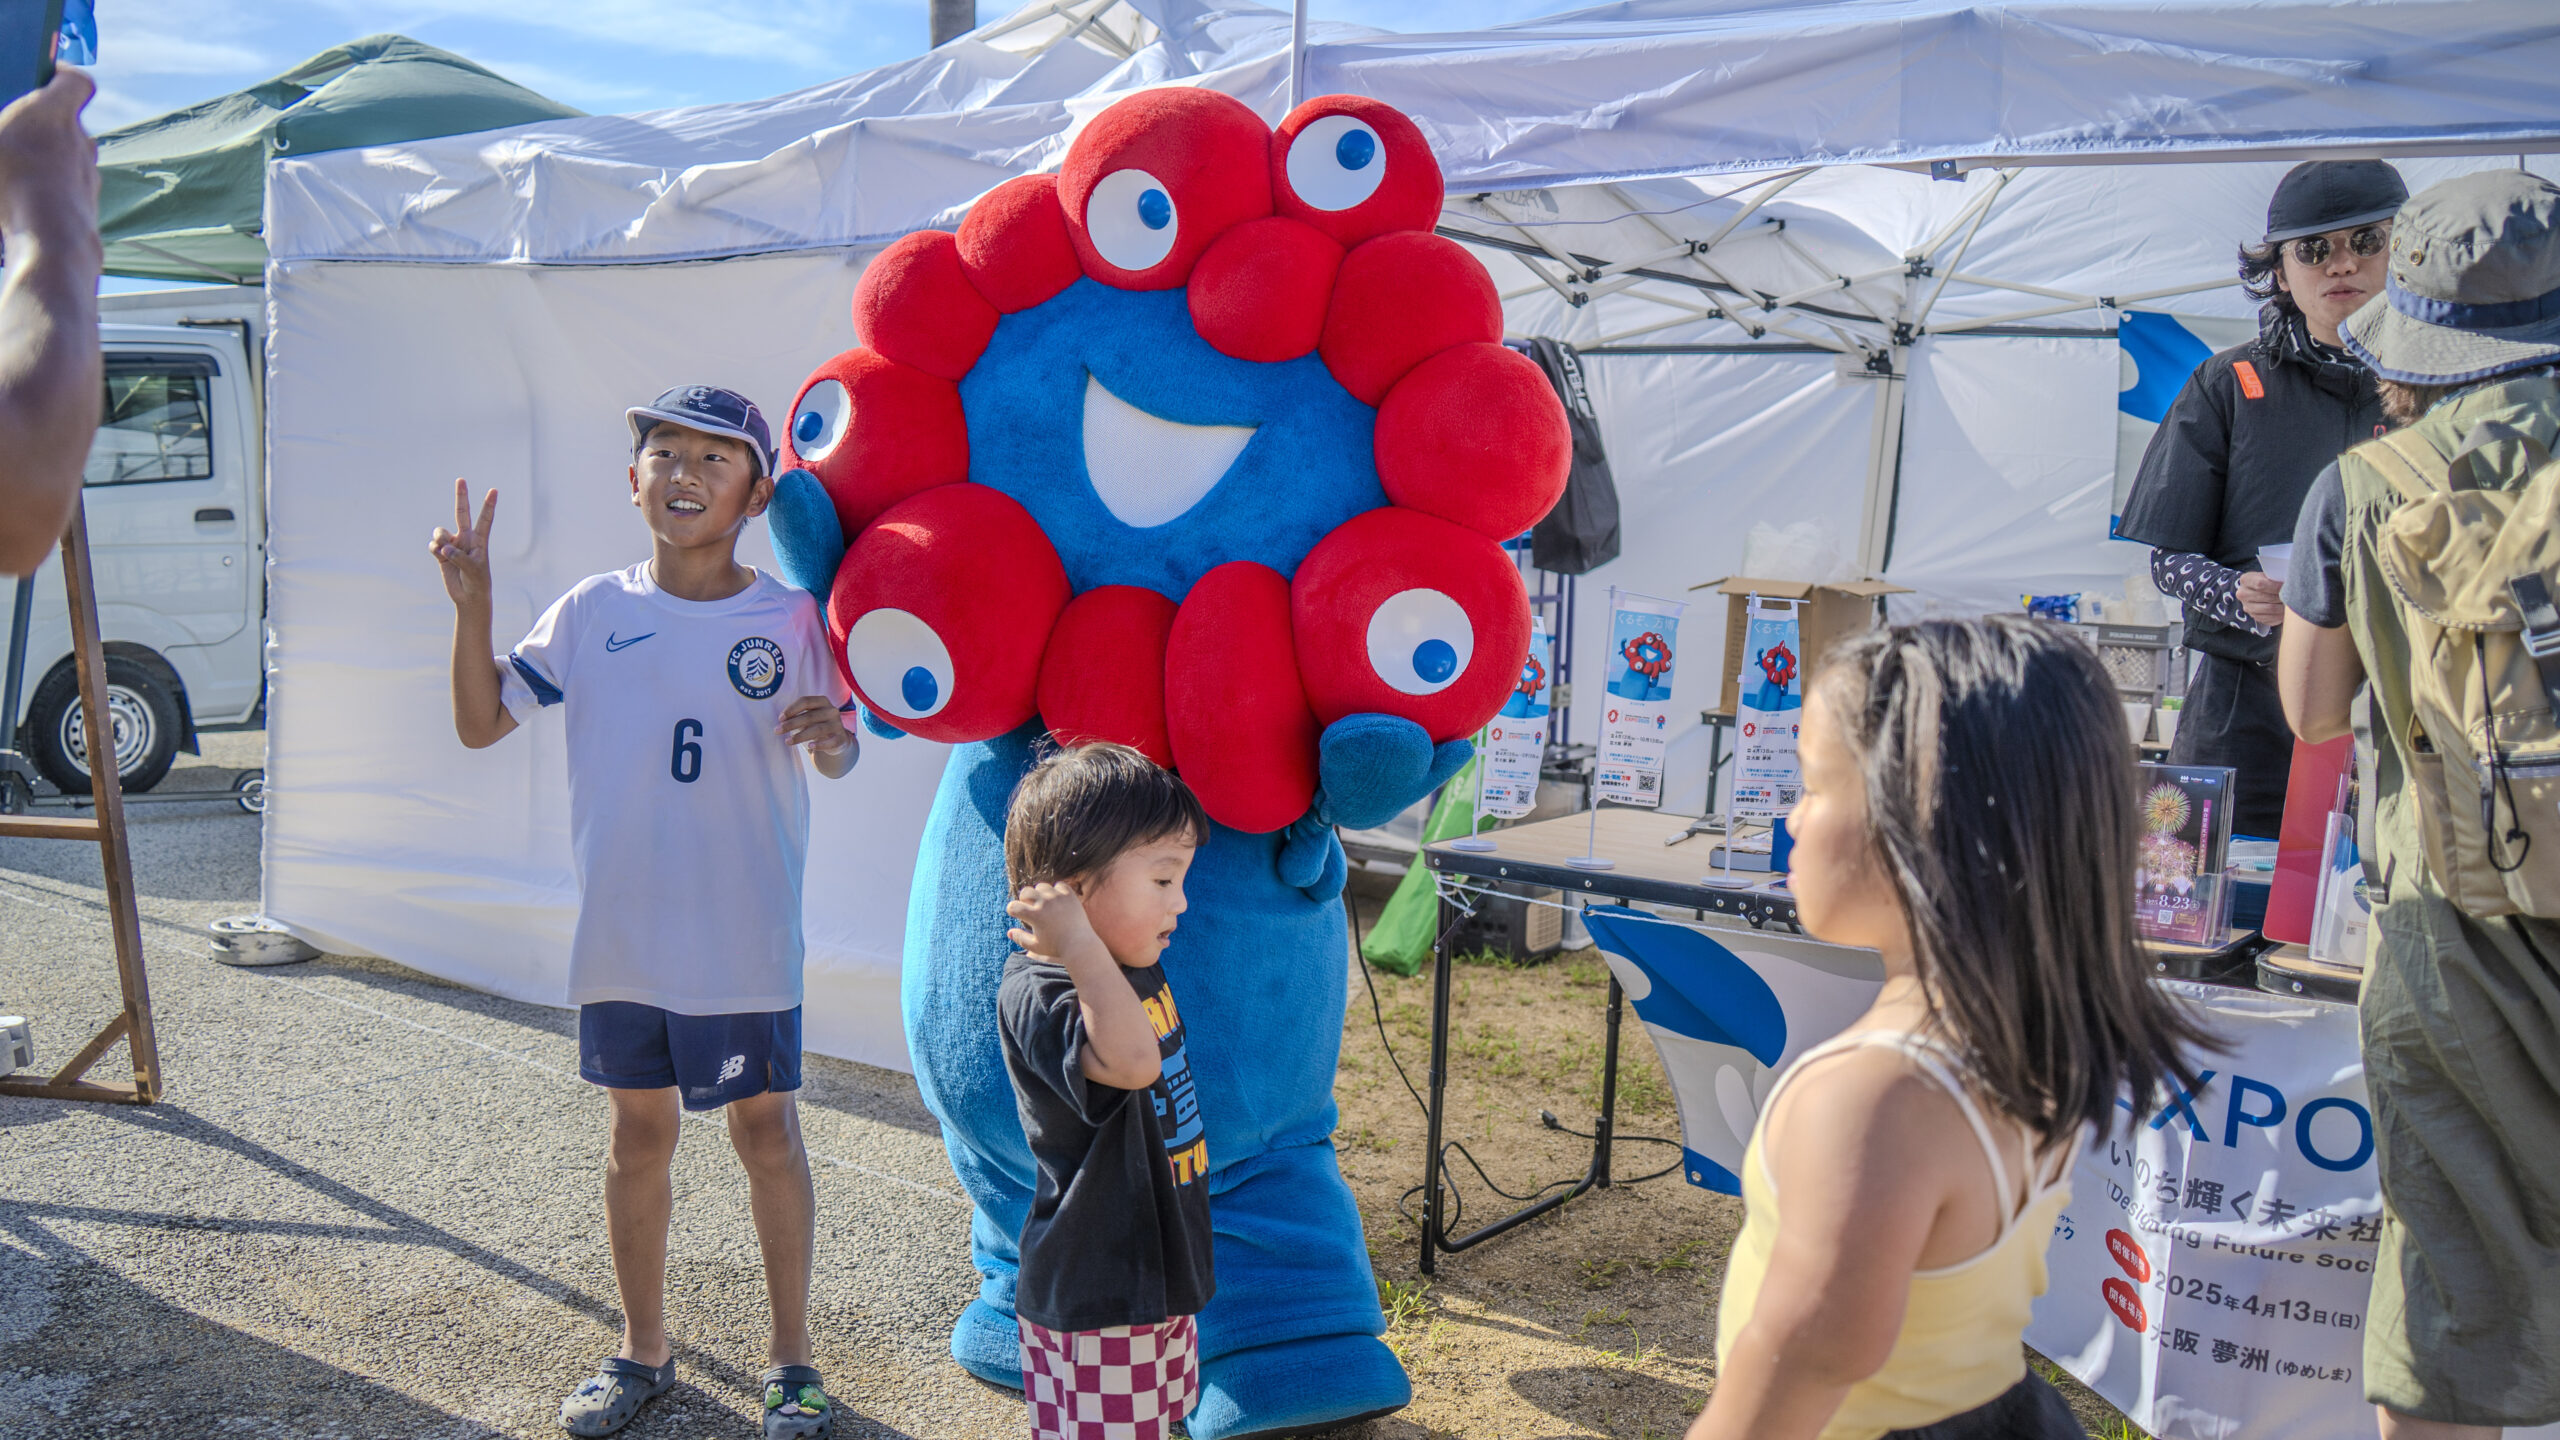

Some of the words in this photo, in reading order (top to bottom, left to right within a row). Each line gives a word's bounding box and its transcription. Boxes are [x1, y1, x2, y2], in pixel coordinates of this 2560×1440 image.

[729, 650, 741, 666] FC
[741, 638, 784, 674] JUNRELO
[756, 687, 771, 697] 2017
[670, 718, 704, 783] 6
[2159, 894, 2190, 909] 8.23
[2112, 1069, 2375, 1172] XPO
[2110, 1140, 2381, 1242] いのち輝く未来社
[2213, 1233, 2305, 1264] Future
[2109, 1286, 2143, 1324] 開催場所
[2150, 1323, 2200, 1355] 大阪
[2211, 1338, 2270, 1373] 夢洲
